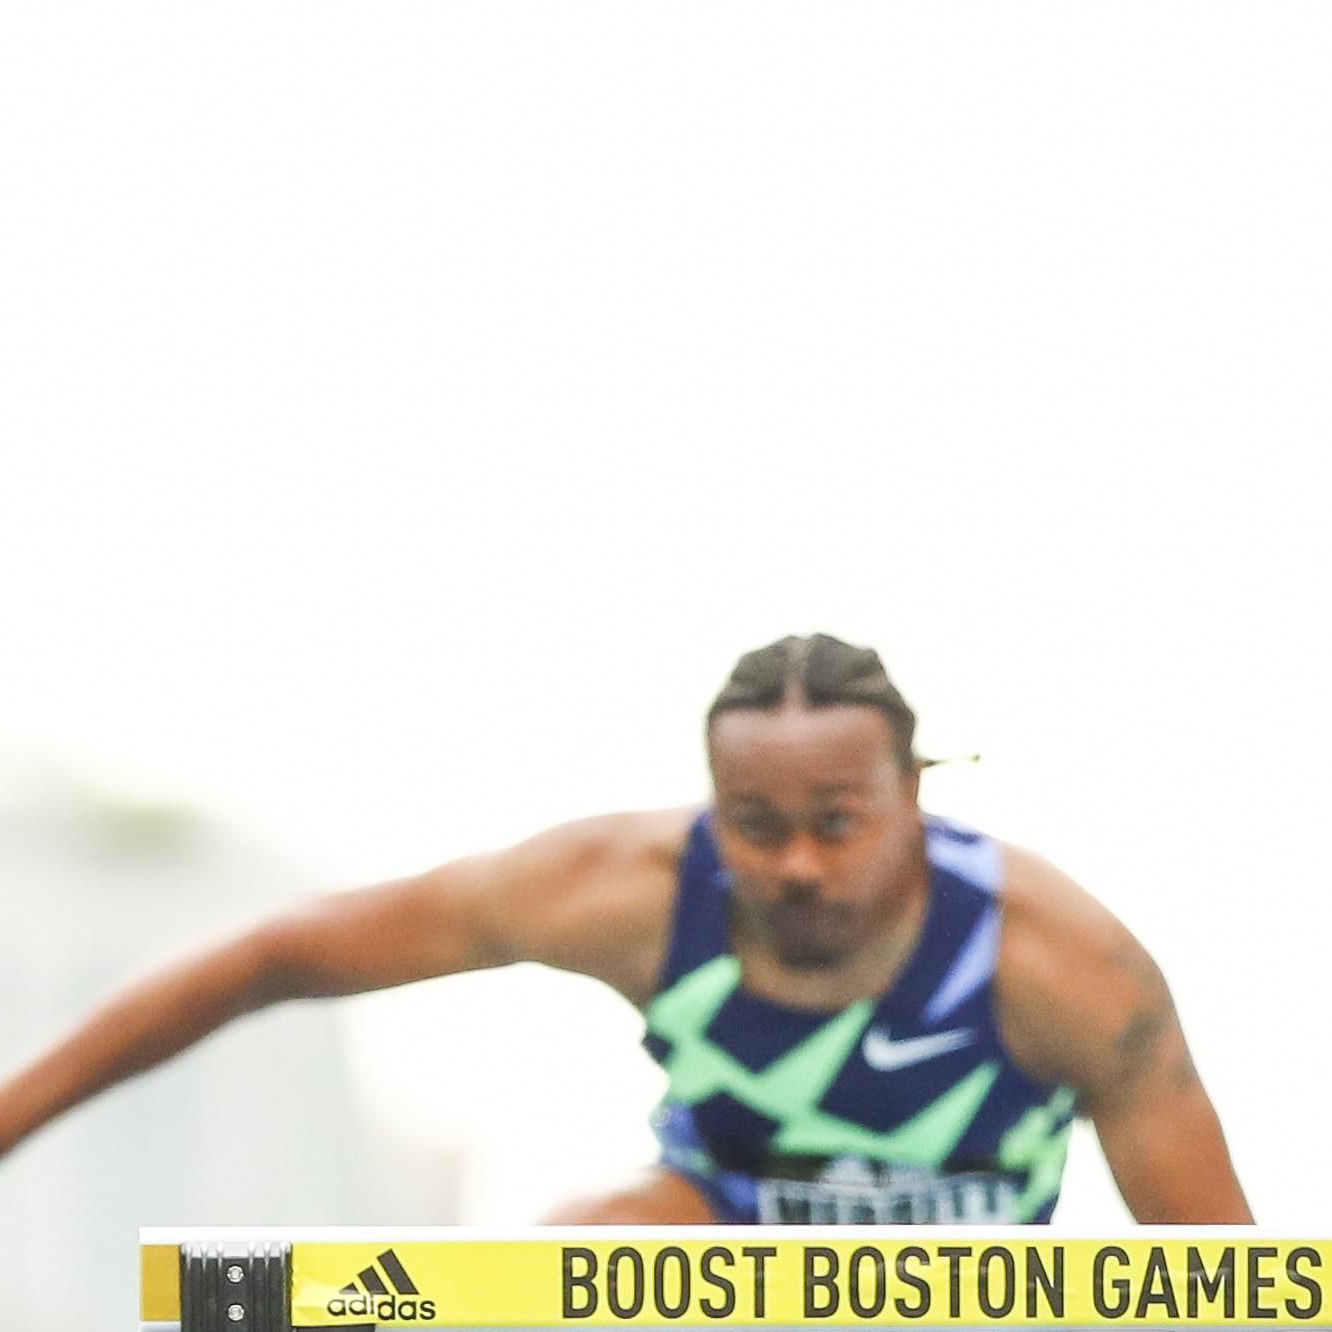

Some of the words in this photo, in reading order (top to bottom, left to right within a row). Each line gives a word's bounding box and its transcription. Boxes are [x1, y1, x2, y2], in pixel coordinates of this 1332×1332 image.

[326, 1293, 437, 1321] adidas
[562, 1246, 777, 1320] BOOST
[803, 1245, 1065, 1319] BOSTON
[1092, 1246, 1322, 1320] GAMES
